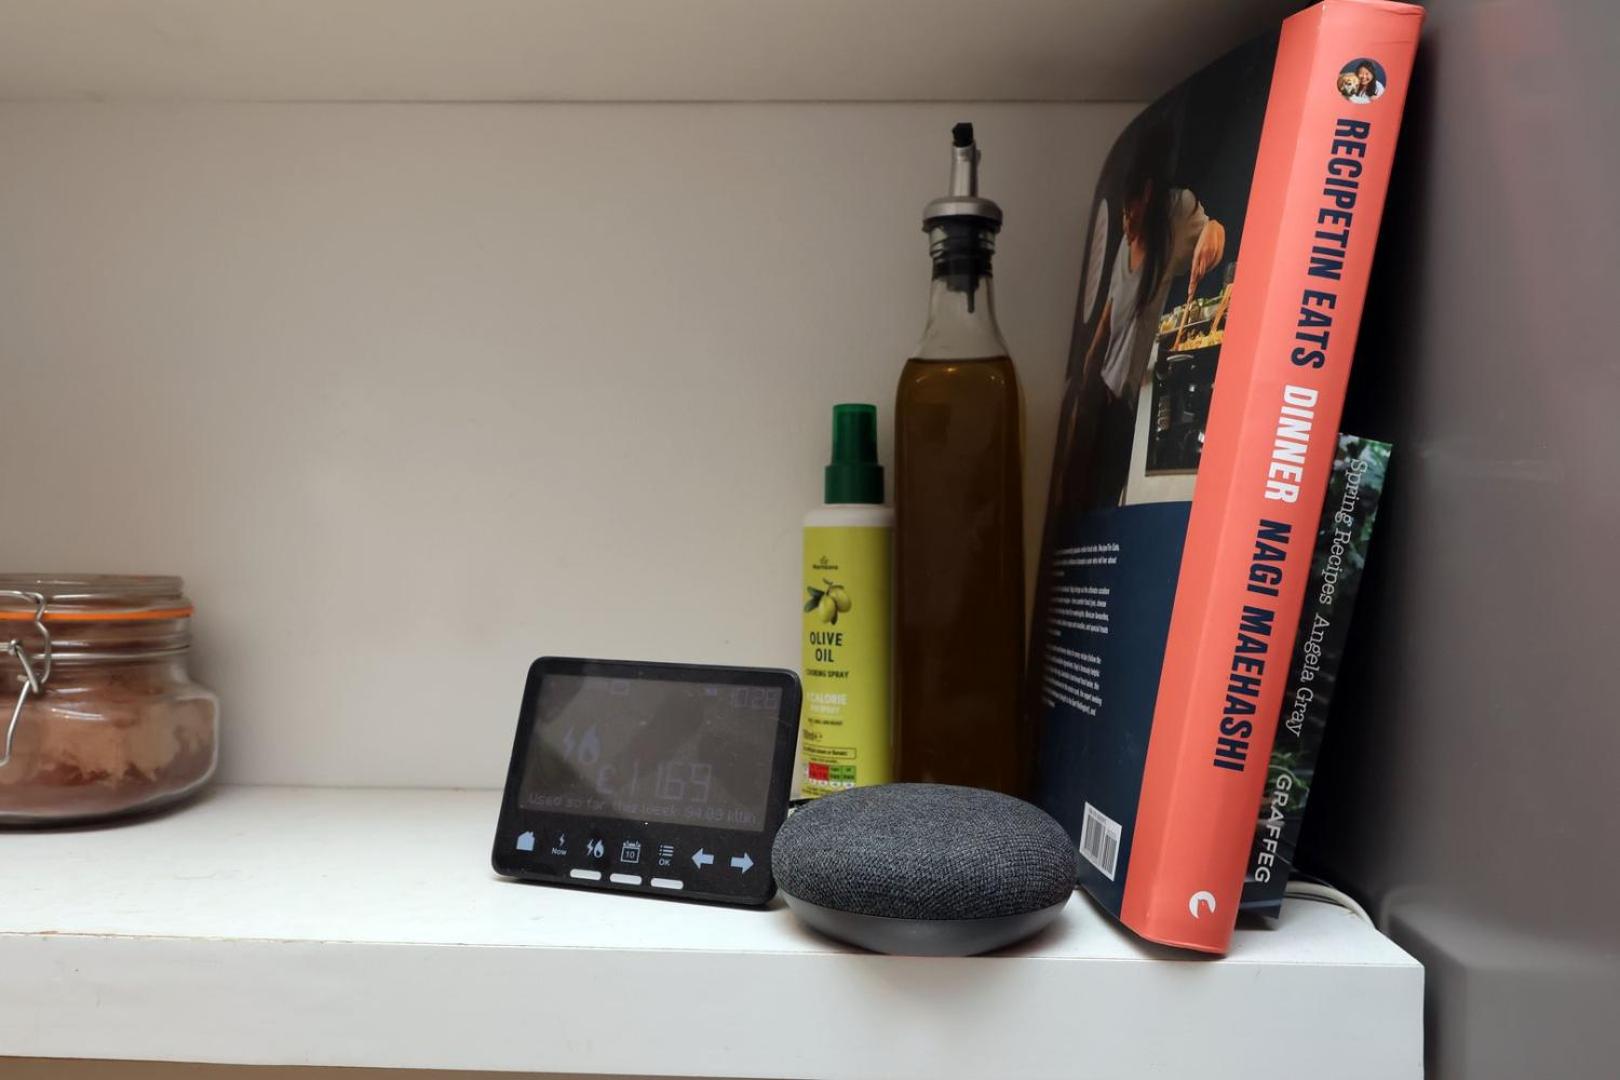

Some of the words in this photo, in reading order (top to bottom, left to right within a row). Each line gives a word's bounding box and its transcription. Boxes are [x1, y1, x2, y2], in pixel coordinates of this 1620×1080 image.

[1307, 118, 1371, 281] RECIPETIN
[1290, 293, 1337, 369] EATS
[1264, 384, 1318, 503] DINNER
[1334, 459, 1369, 527] Spring
[1247, 518, 1292, 597] NAGI
[1319, 528, 1352, 605] Recipes
[809, 631, 843, 647] OLIVE
[815, 648, 834, 662] OIL
[1303, 612, 1331, 683] Angela
[827, 670, 849, 678] SPRAY
[1213, 605, 1275, 771] MAEHASHI
[1285, 687, 1314, 737] Gray
[551, 847, 567, 855] Now
[625, 850, 635, 859] 10
[658, 858, 671, 866] OK
[1254, 774, 1293, 883] GRAFFEG
